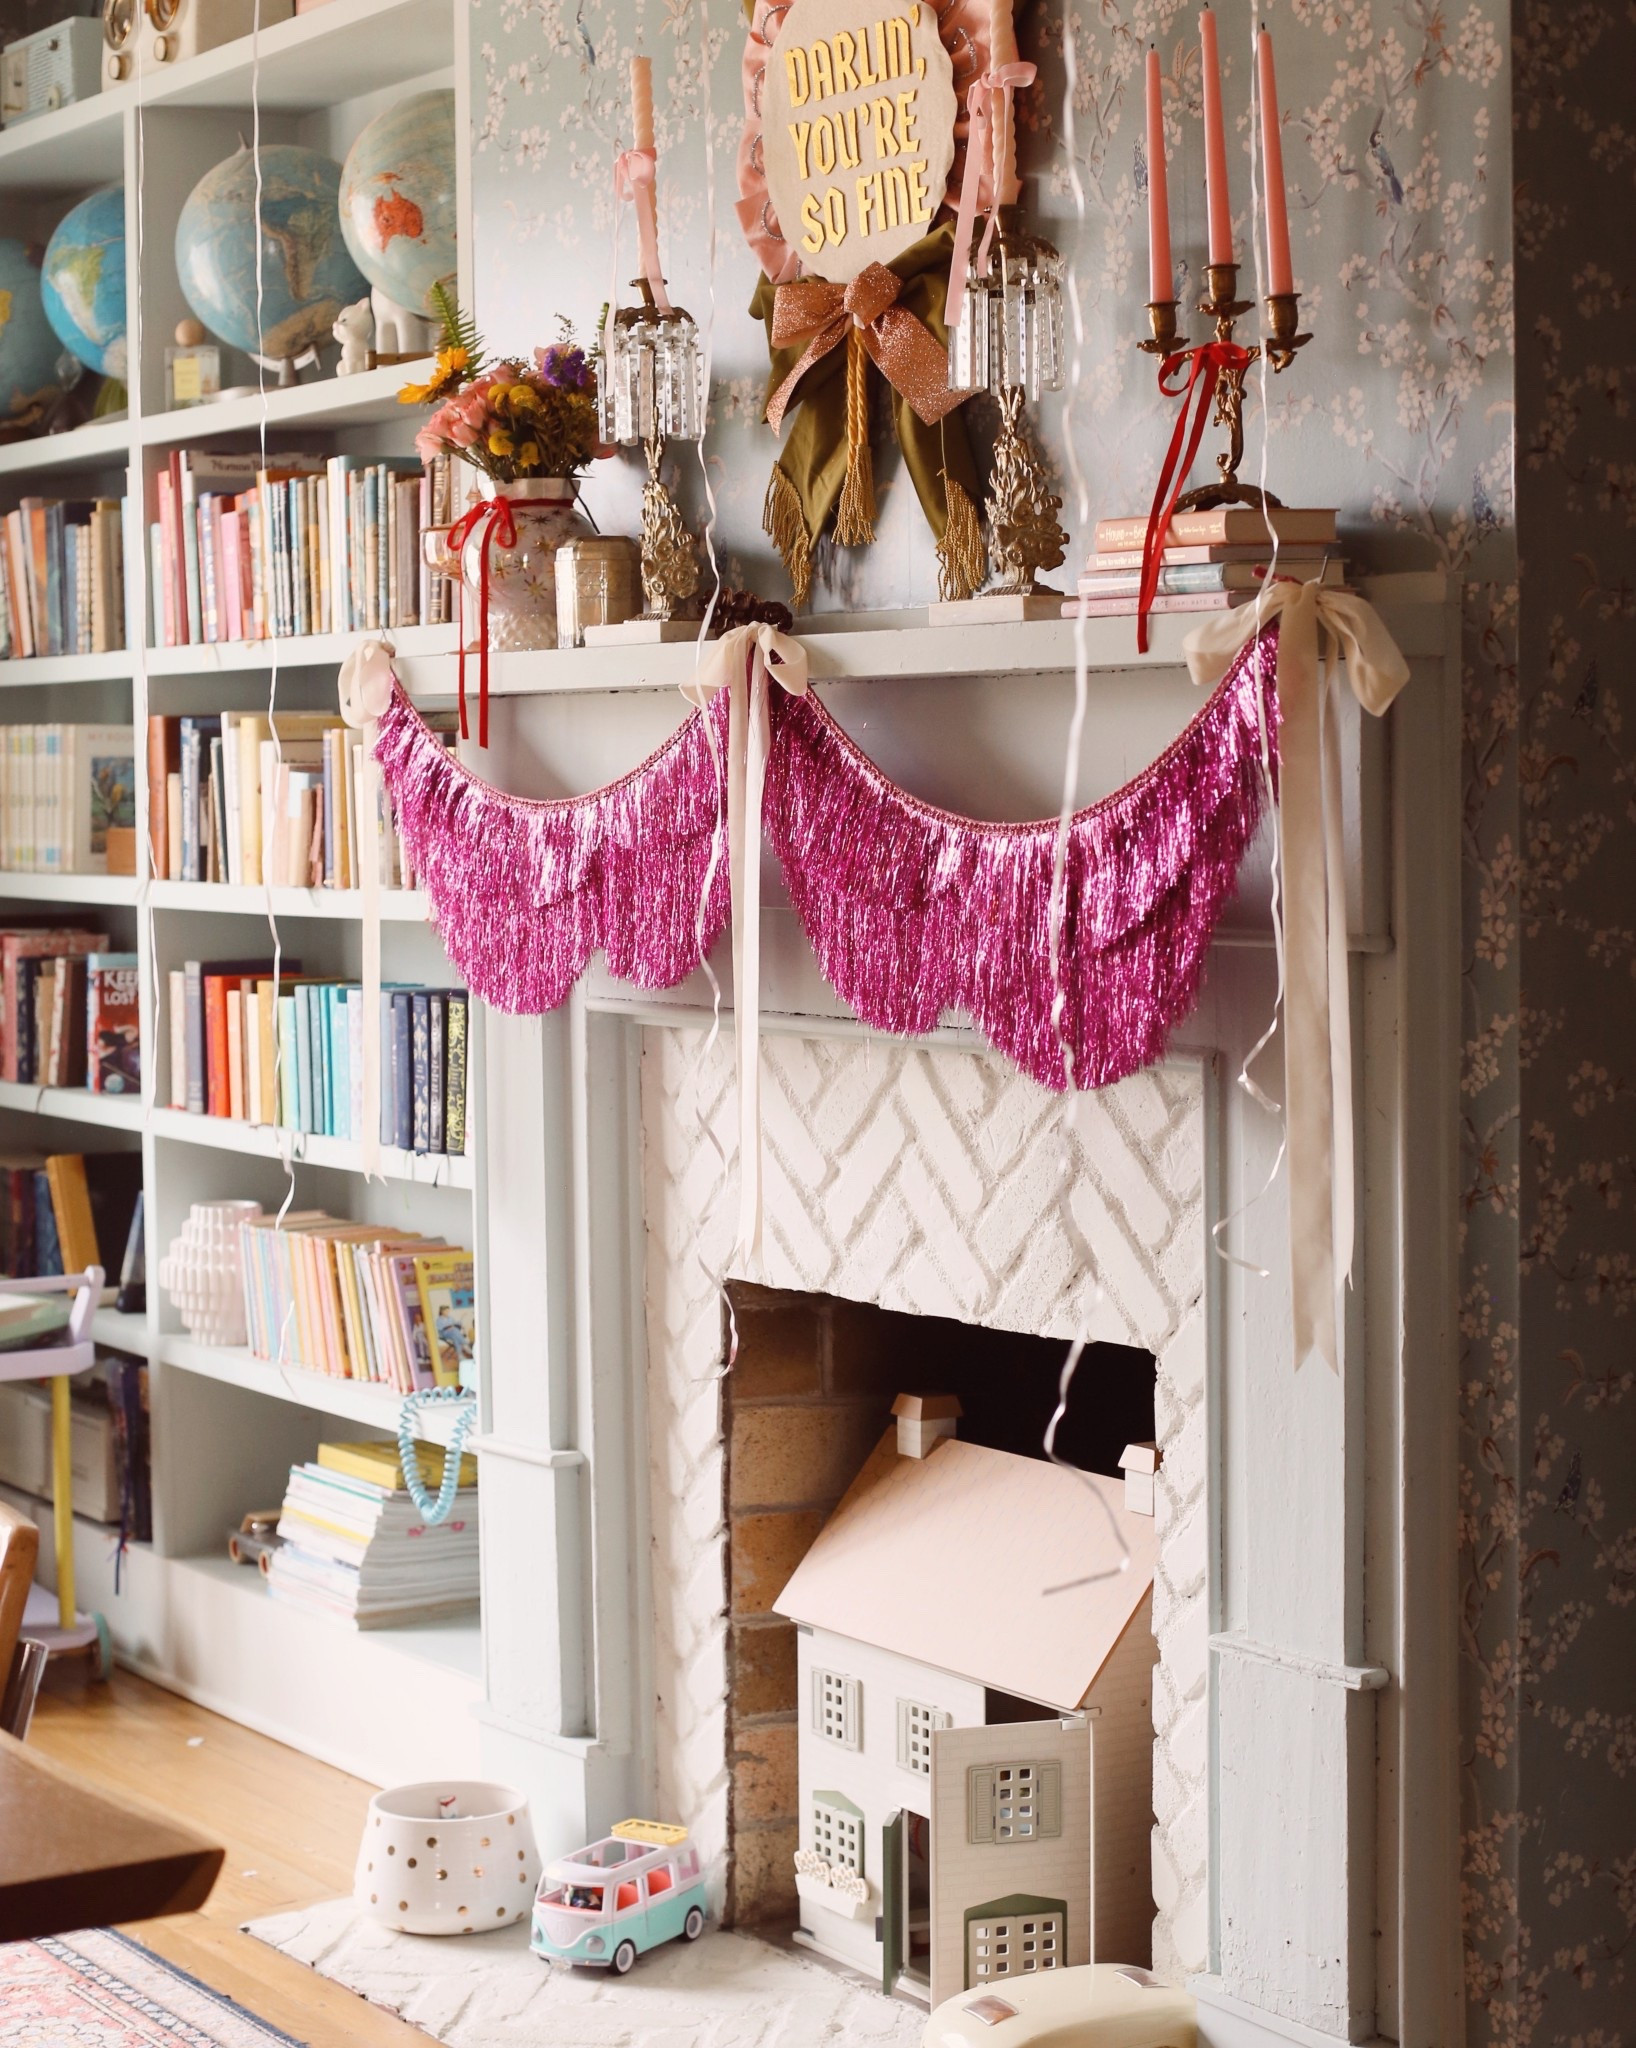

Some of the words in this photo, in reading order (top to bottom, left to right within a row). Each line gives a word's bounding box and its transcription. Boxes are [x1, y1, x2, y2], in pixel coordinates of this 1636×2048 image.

[788, 89, 920, 180] YOU'RE
[800, 186, 847, 254] SO
[856, 159, 934, 238] FINE
